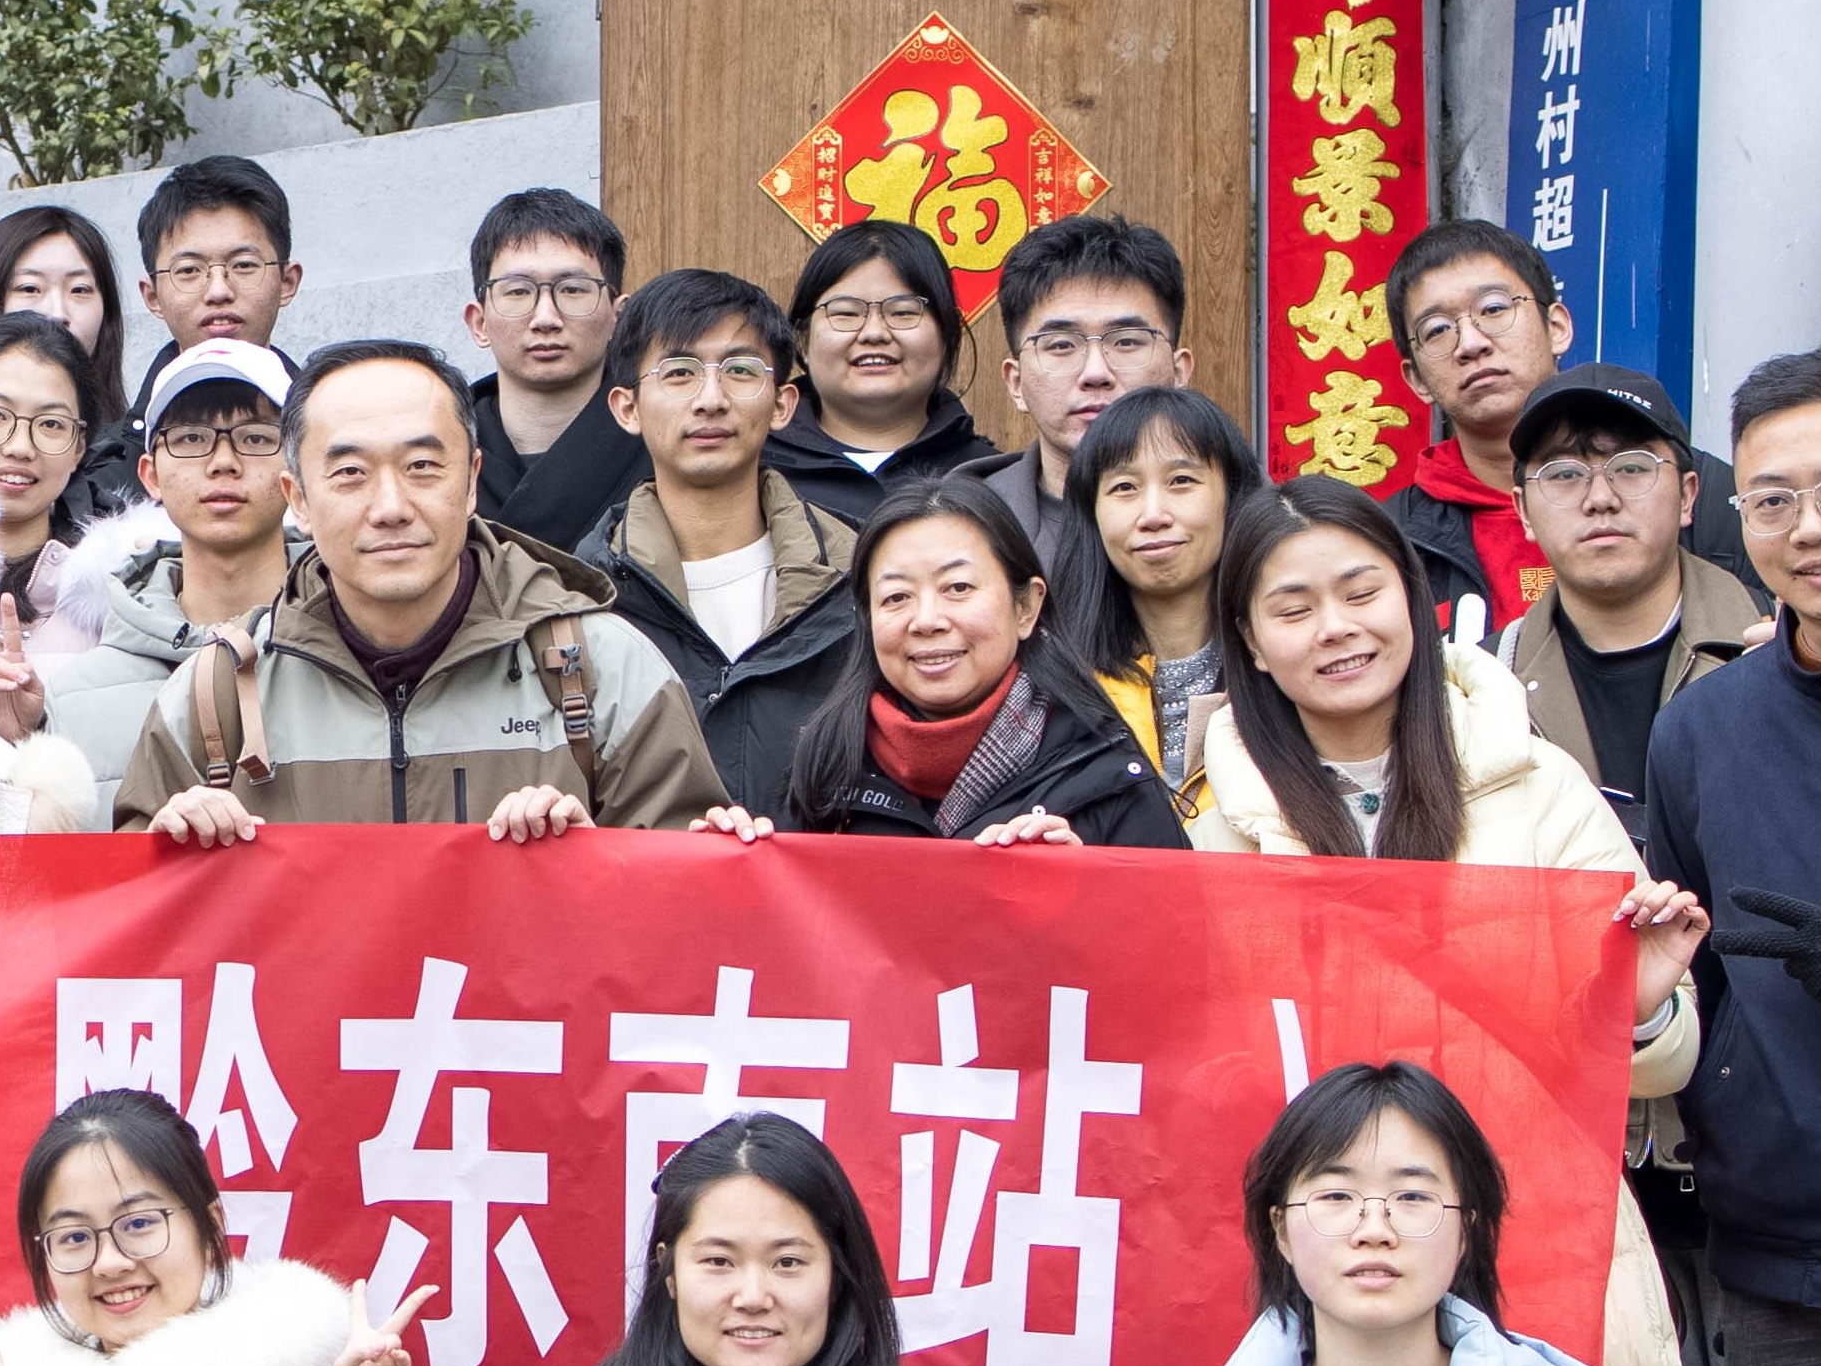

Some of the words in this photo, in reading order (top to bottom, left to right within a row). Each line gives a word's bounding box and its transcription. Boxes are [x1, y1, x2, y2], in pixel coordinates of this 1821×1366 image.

[843, 85, 1028, 272] 福
[1033, 147, 1055, 225] 吉祥如意
